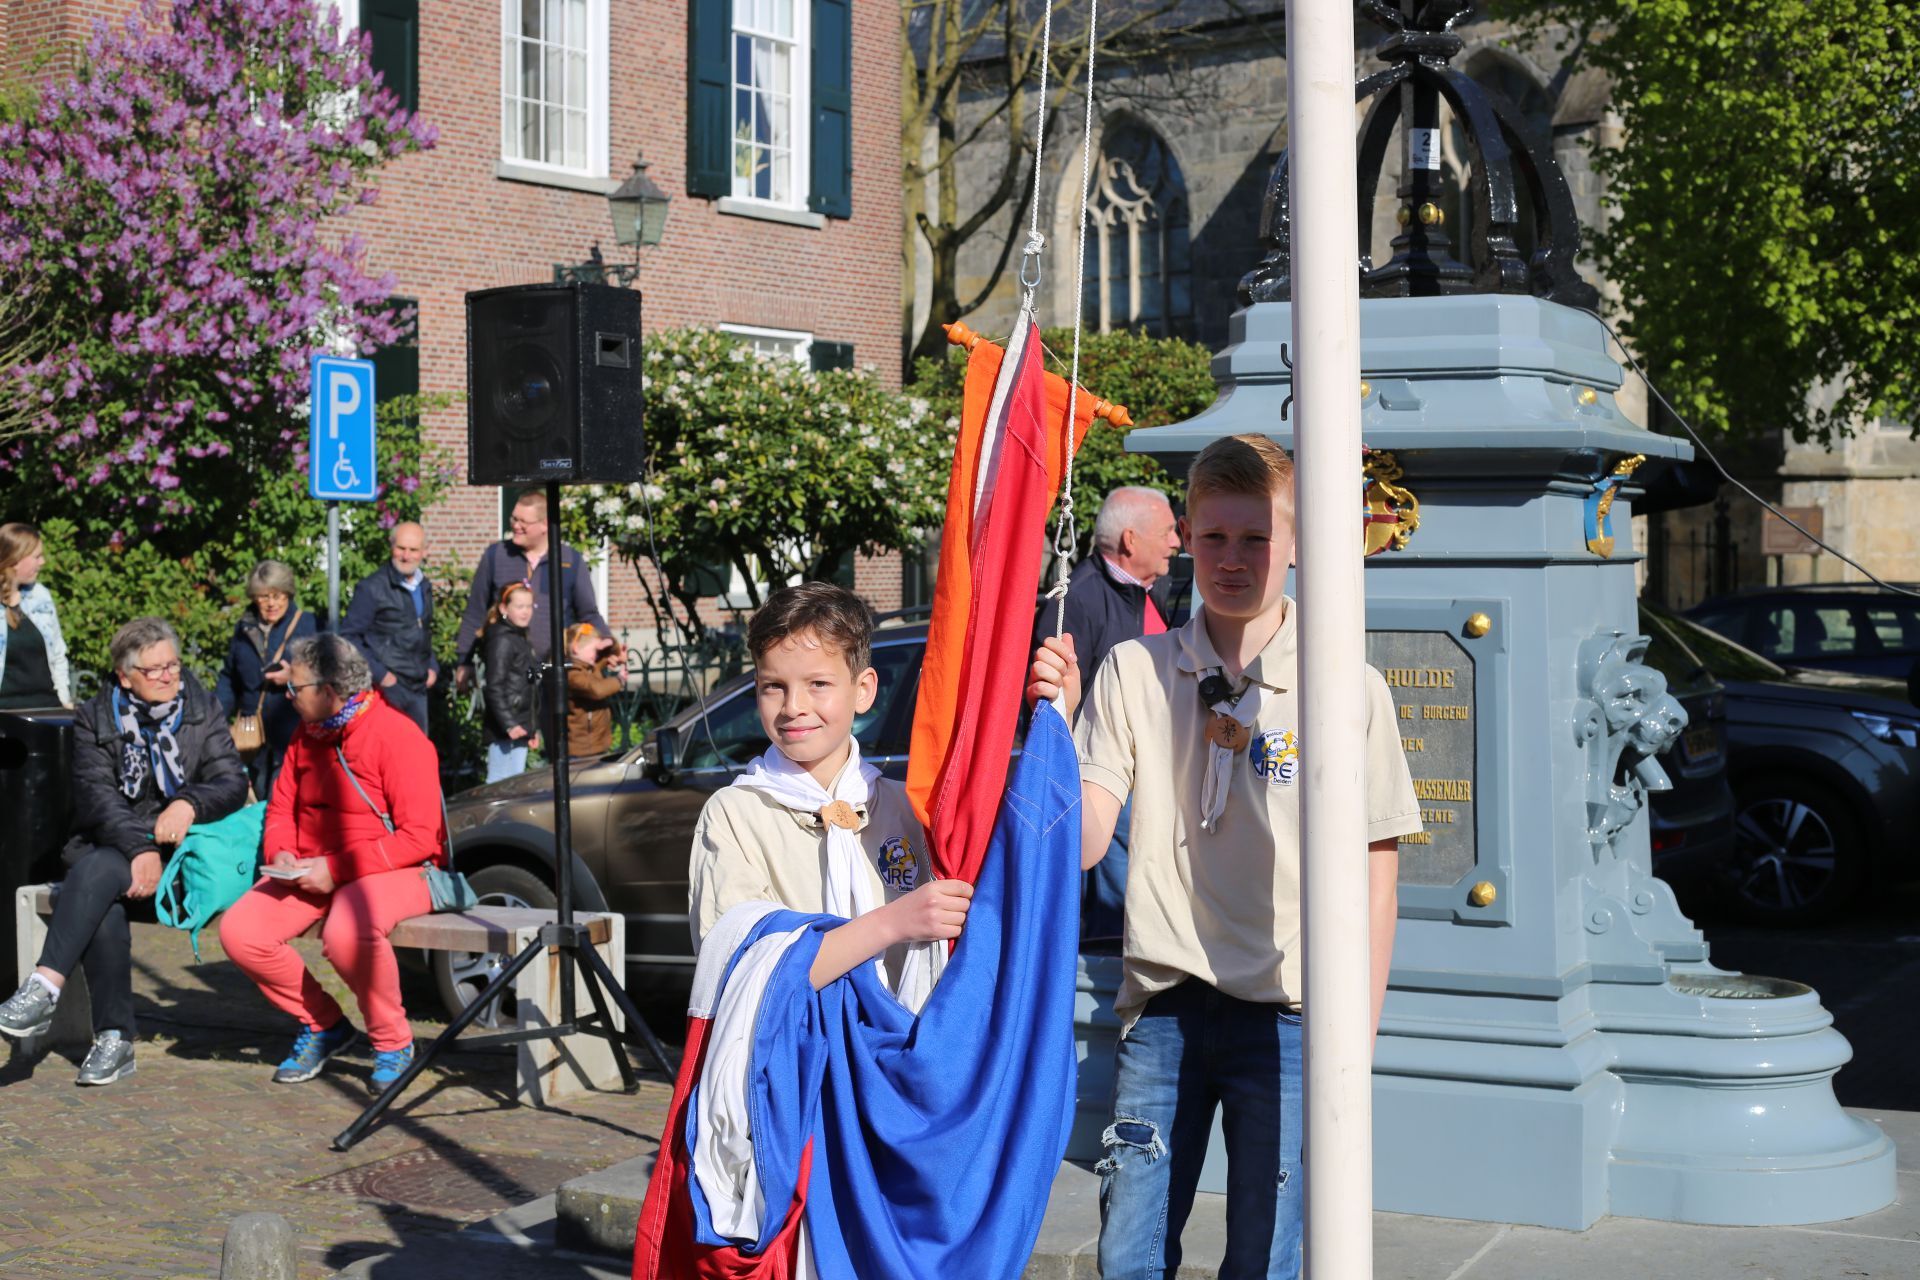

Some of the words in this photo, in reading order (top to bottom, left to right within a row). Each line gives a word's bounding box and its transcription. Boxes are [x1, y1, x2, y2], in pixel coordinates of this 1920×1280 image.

[1422, 132, 1431, 146] 2
[329, 371, 361, 439] P
[1385, 669, 1455, 688] HULDE
[1400, 705, 1414, 719] DE
[1420, 809, 1453, 823] EENTE
